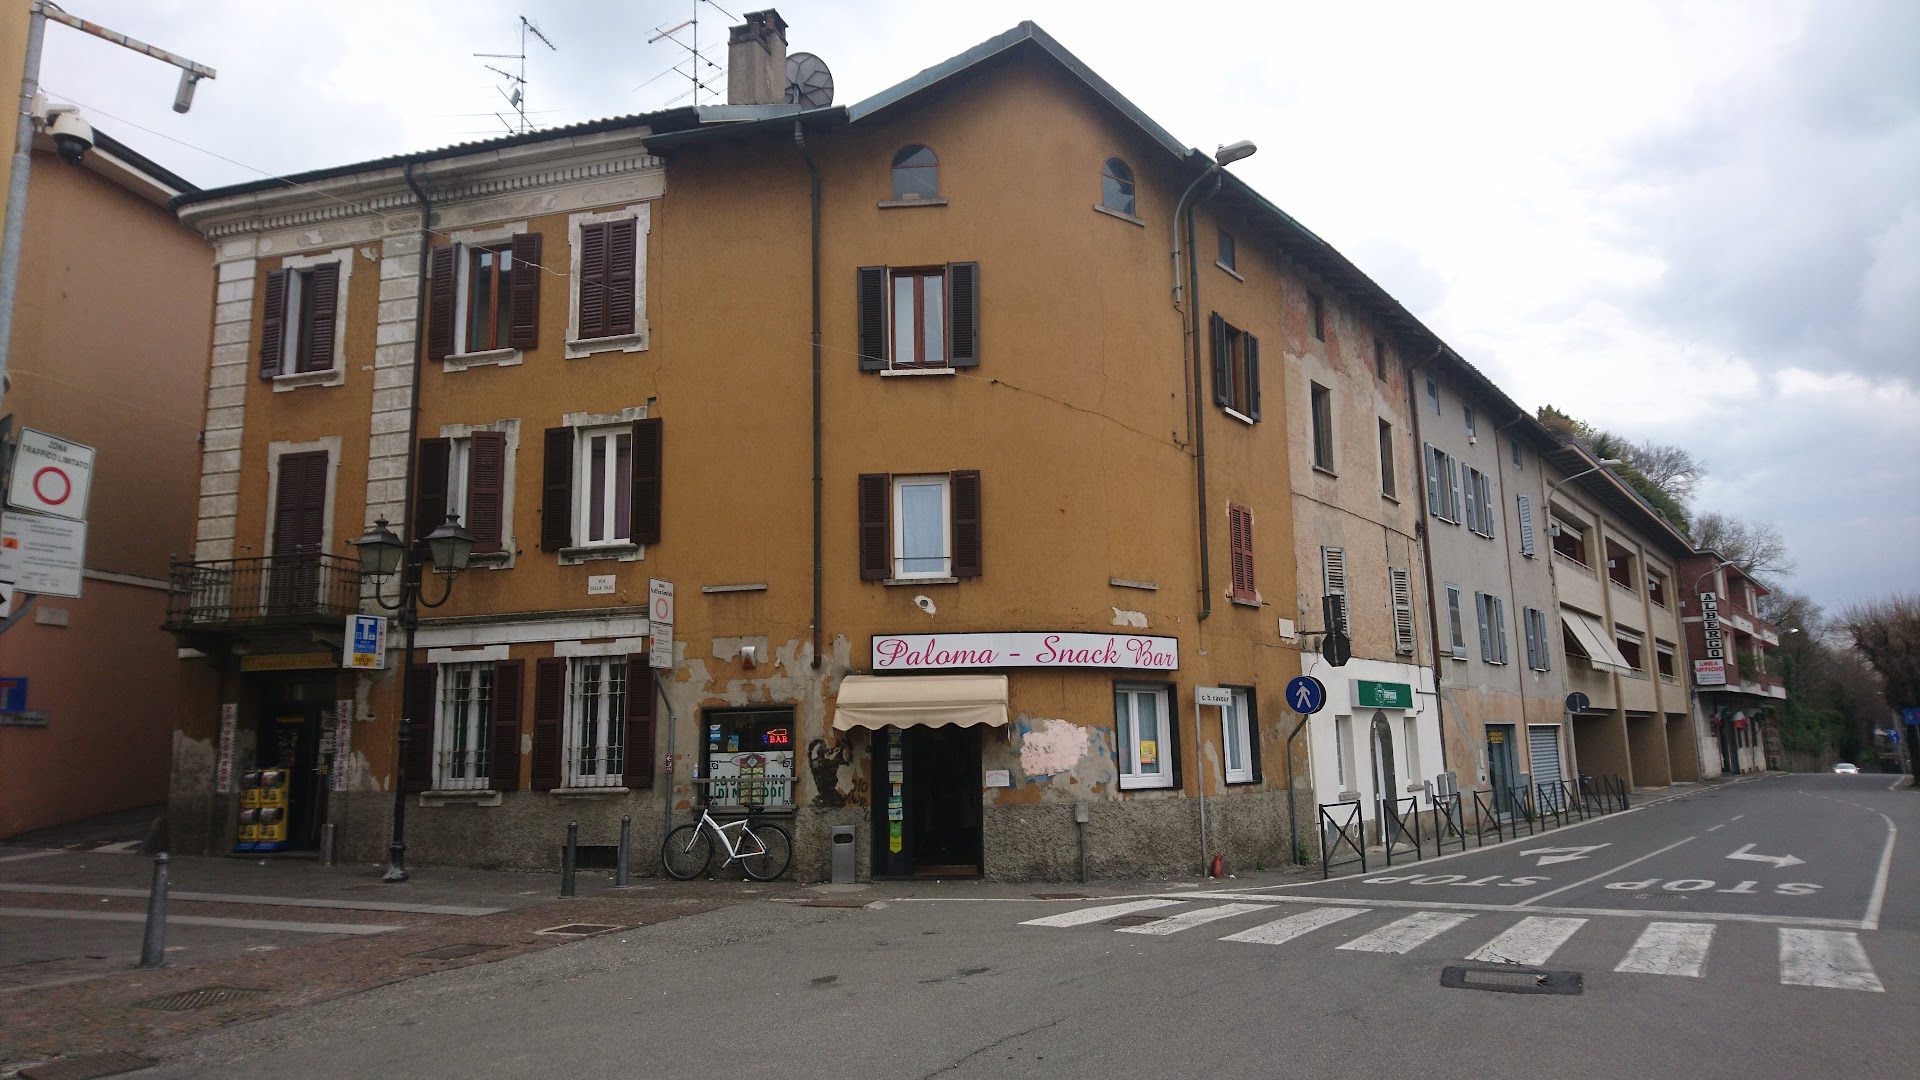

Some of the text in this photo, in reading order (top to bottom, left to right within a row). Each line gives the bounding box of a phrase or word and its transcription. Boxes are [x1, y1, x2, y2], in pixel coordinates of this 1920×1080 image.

[22, 444, 88, 469] TRAFFICO LIMITATO
[48, 441, 67, 452] ZONA
[359, 618, 374, 640] T
[1704, 593, 1720, 657] ALBERGO
[876, 637, 999, 668] Paloma
[1035, 635, 1122, 665] Snack
[1125, 637, 1175, 668] Bar
[769, 735, 788, 744] BAR
[1362, 873, 1552, 888] STOP
[1603, 877, 1824, 896] STOP
